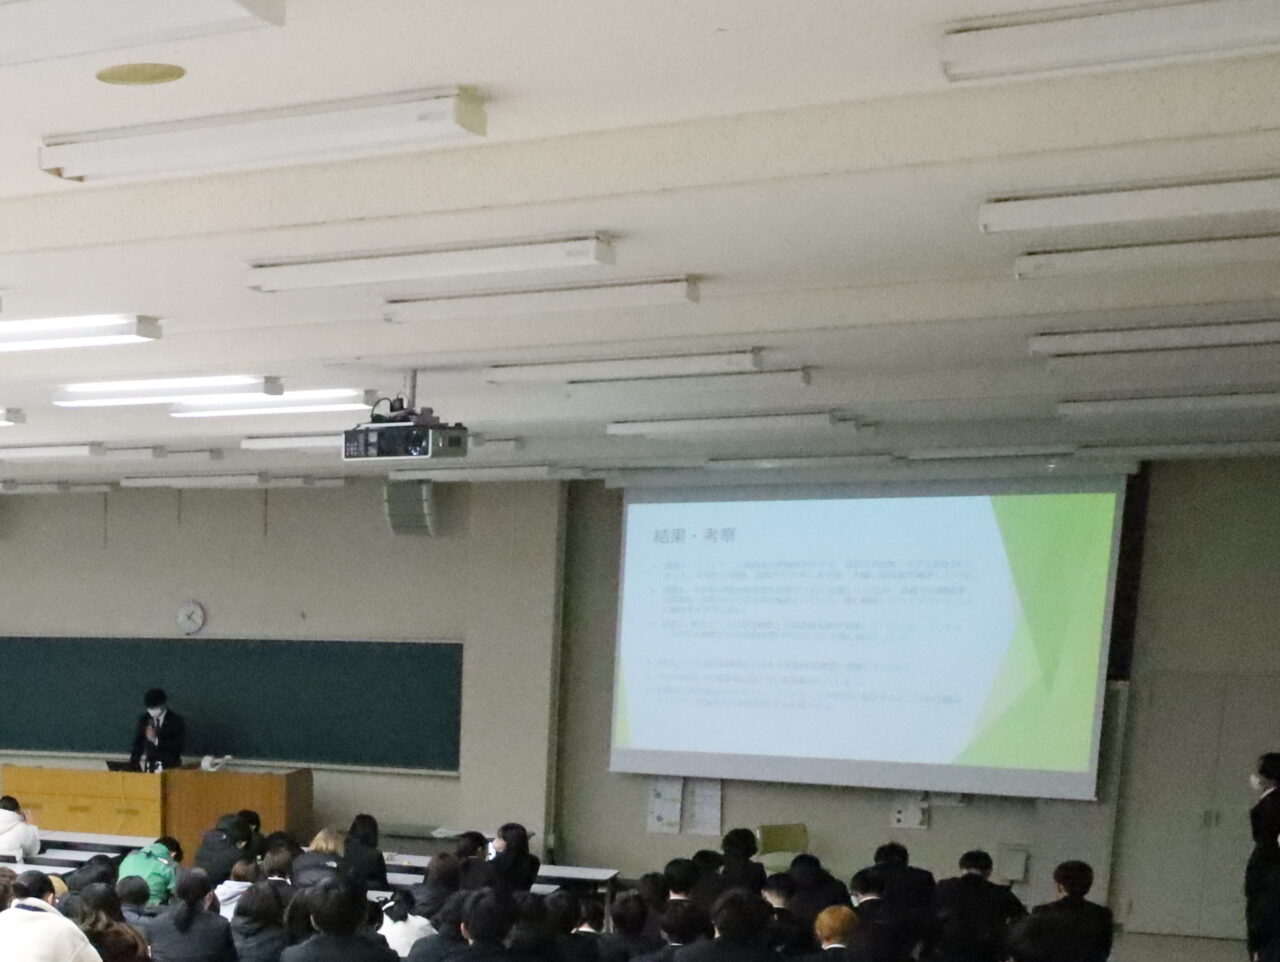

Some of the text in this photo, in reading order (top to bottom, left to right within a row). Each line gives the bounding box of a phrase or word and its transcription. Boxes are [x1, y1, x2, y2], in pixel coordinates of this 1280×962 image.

[653, 527, 736, 545] 結果・考察
